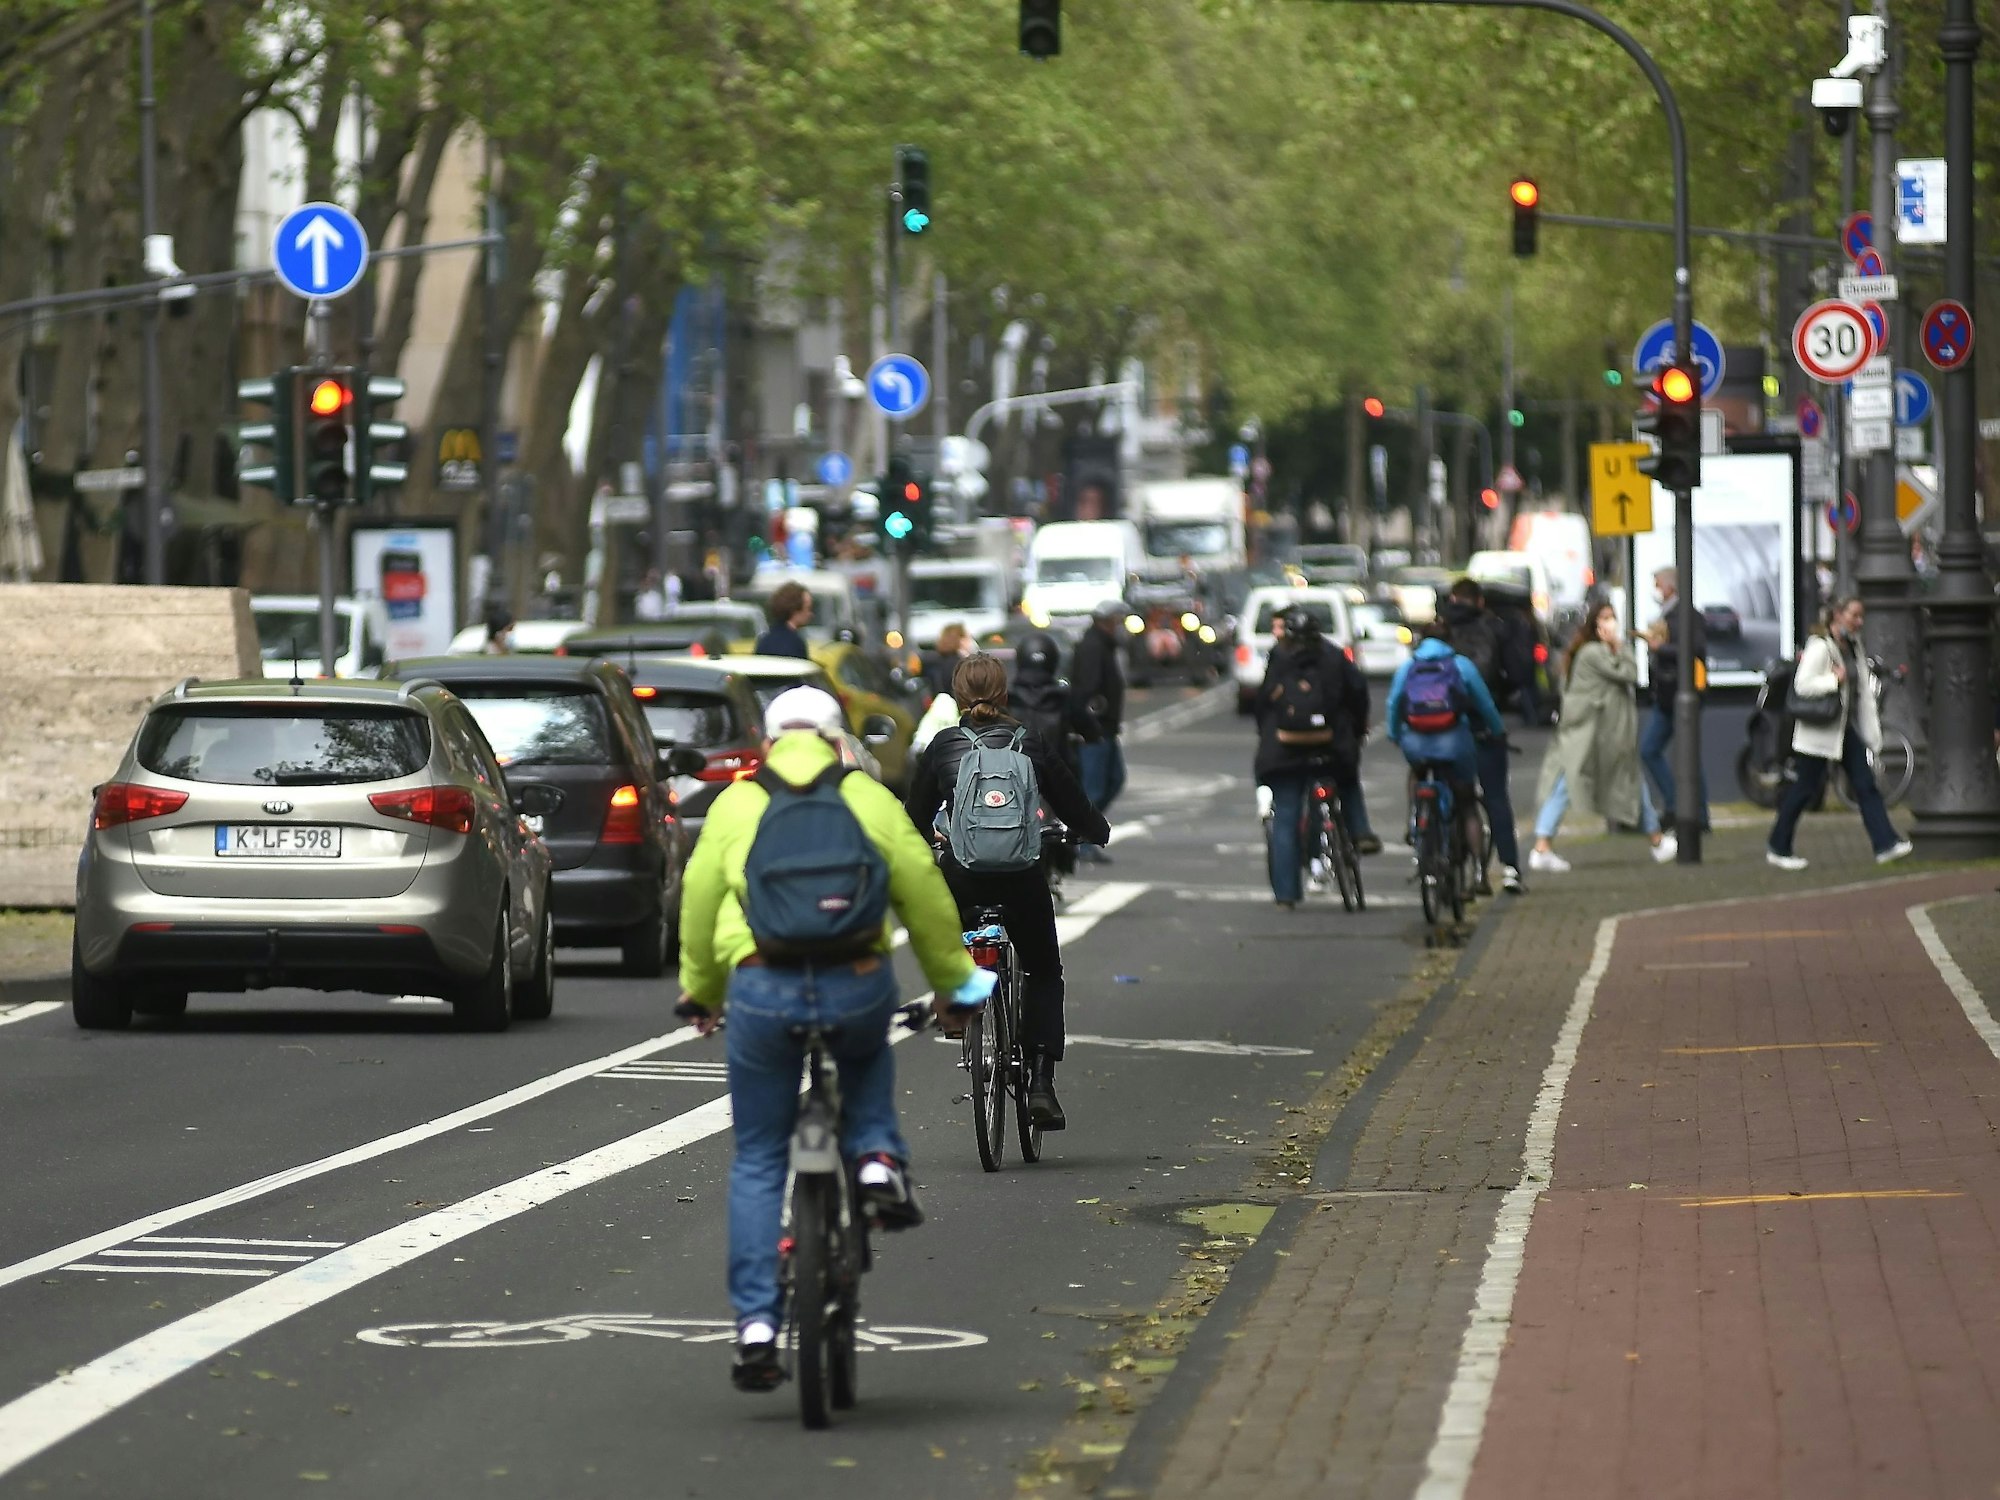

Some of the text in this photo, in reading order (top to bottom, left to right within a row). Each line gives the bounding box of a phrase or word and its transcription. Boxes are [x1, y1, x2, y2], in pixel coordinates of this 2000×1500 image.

[1813, 323, 1857, 358] 30
[236, 829, 332, 849] K LF 598
